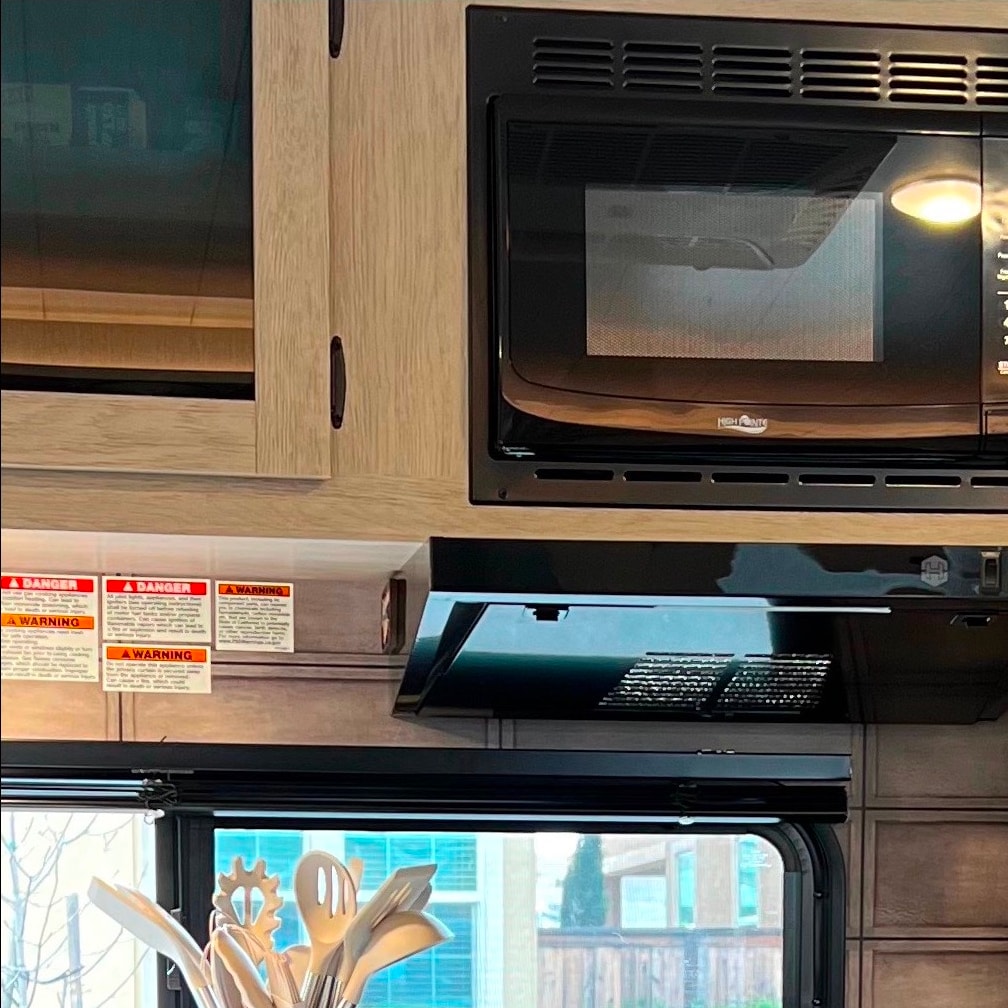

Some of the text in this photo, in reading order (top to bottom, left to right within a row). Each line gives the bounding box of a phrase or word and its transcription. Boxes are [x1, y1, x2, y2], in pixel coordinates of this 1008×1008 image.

[22, 577, 78, 591] DANGER
[136, 581, 191, 593] DANGER
[236, 585, 283, 595] WARNING
[19, 616, 80, 627] WARNING
[133, 648, 193, 660] WARNING
